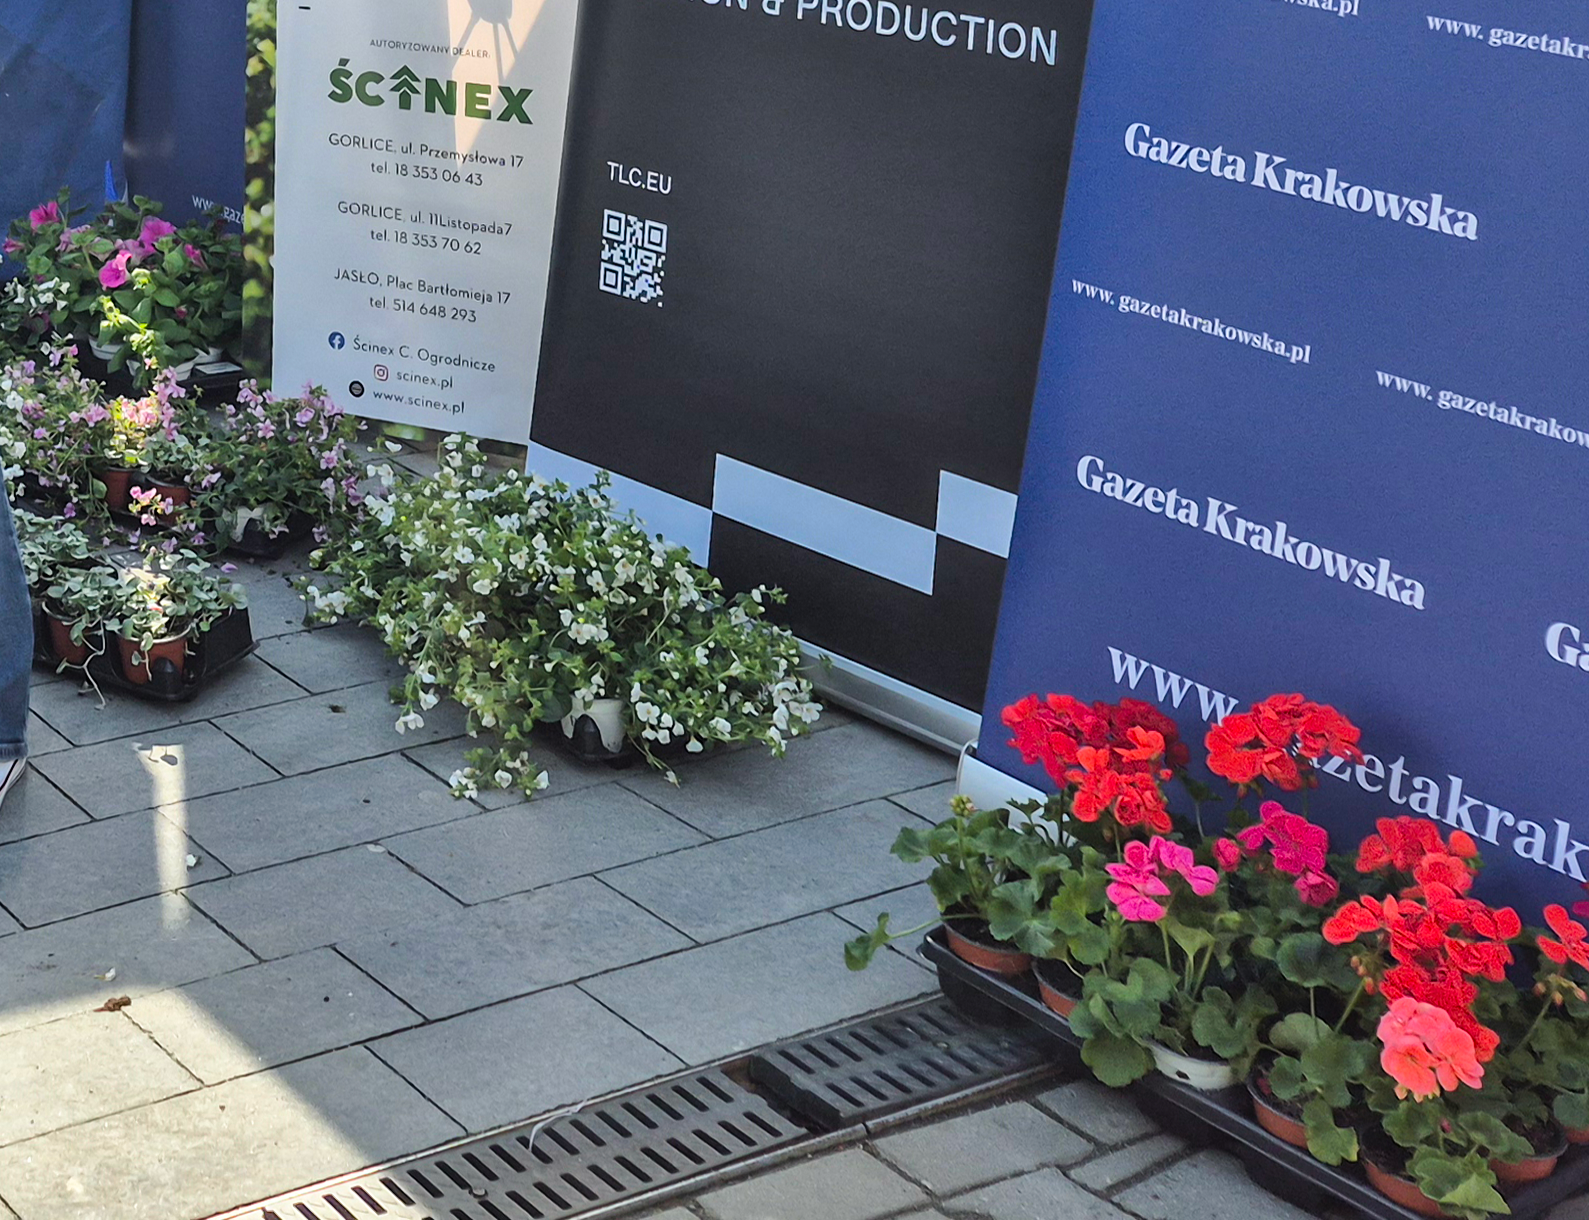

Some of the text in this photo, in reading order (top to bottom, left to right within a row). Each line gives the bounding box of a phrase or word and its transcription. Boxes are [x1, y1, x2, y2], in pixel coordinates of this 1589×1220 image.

[369, 39, 450, 55] AUTORYZOWANY
[1488, 26, 1589, 60] gazetakr
[401, 142, 416, 156] ul.
[420, 143, 507, 168] Przemysłowa
[510, 155, 525, 169] 17
[371, 162, 484, 187] tel. 18 353 06 43
[606, 161, 672, 195] TLC.EU
[1124, 122, 1479, 240] Gazeta Krakowska
[410, 211, 425, 224] ul.
[370, 229, 482, 256] tel. 18 353 70 62
[387, 274, 413, 291] Plac
[417, 279, 493, 305] Bartłomieja
[497, 291, 511, 305] 17
[393, 298, 415, 314] 514
[419, 303, 447, 319] 648
[451, 307, 477, 324] 293
[1118, 292, 1311, 364] gazetakrakowska.pl
[353, 335, 395, 357] Ścinex
[417, 347, 496, 373] Ogrodnicze
[396, 370, 453, 391] scinex.pl
[372, 390, 465, 415] www.scinex.pl
[1076, 454, 1426, 610] Gazeta Krakowska
